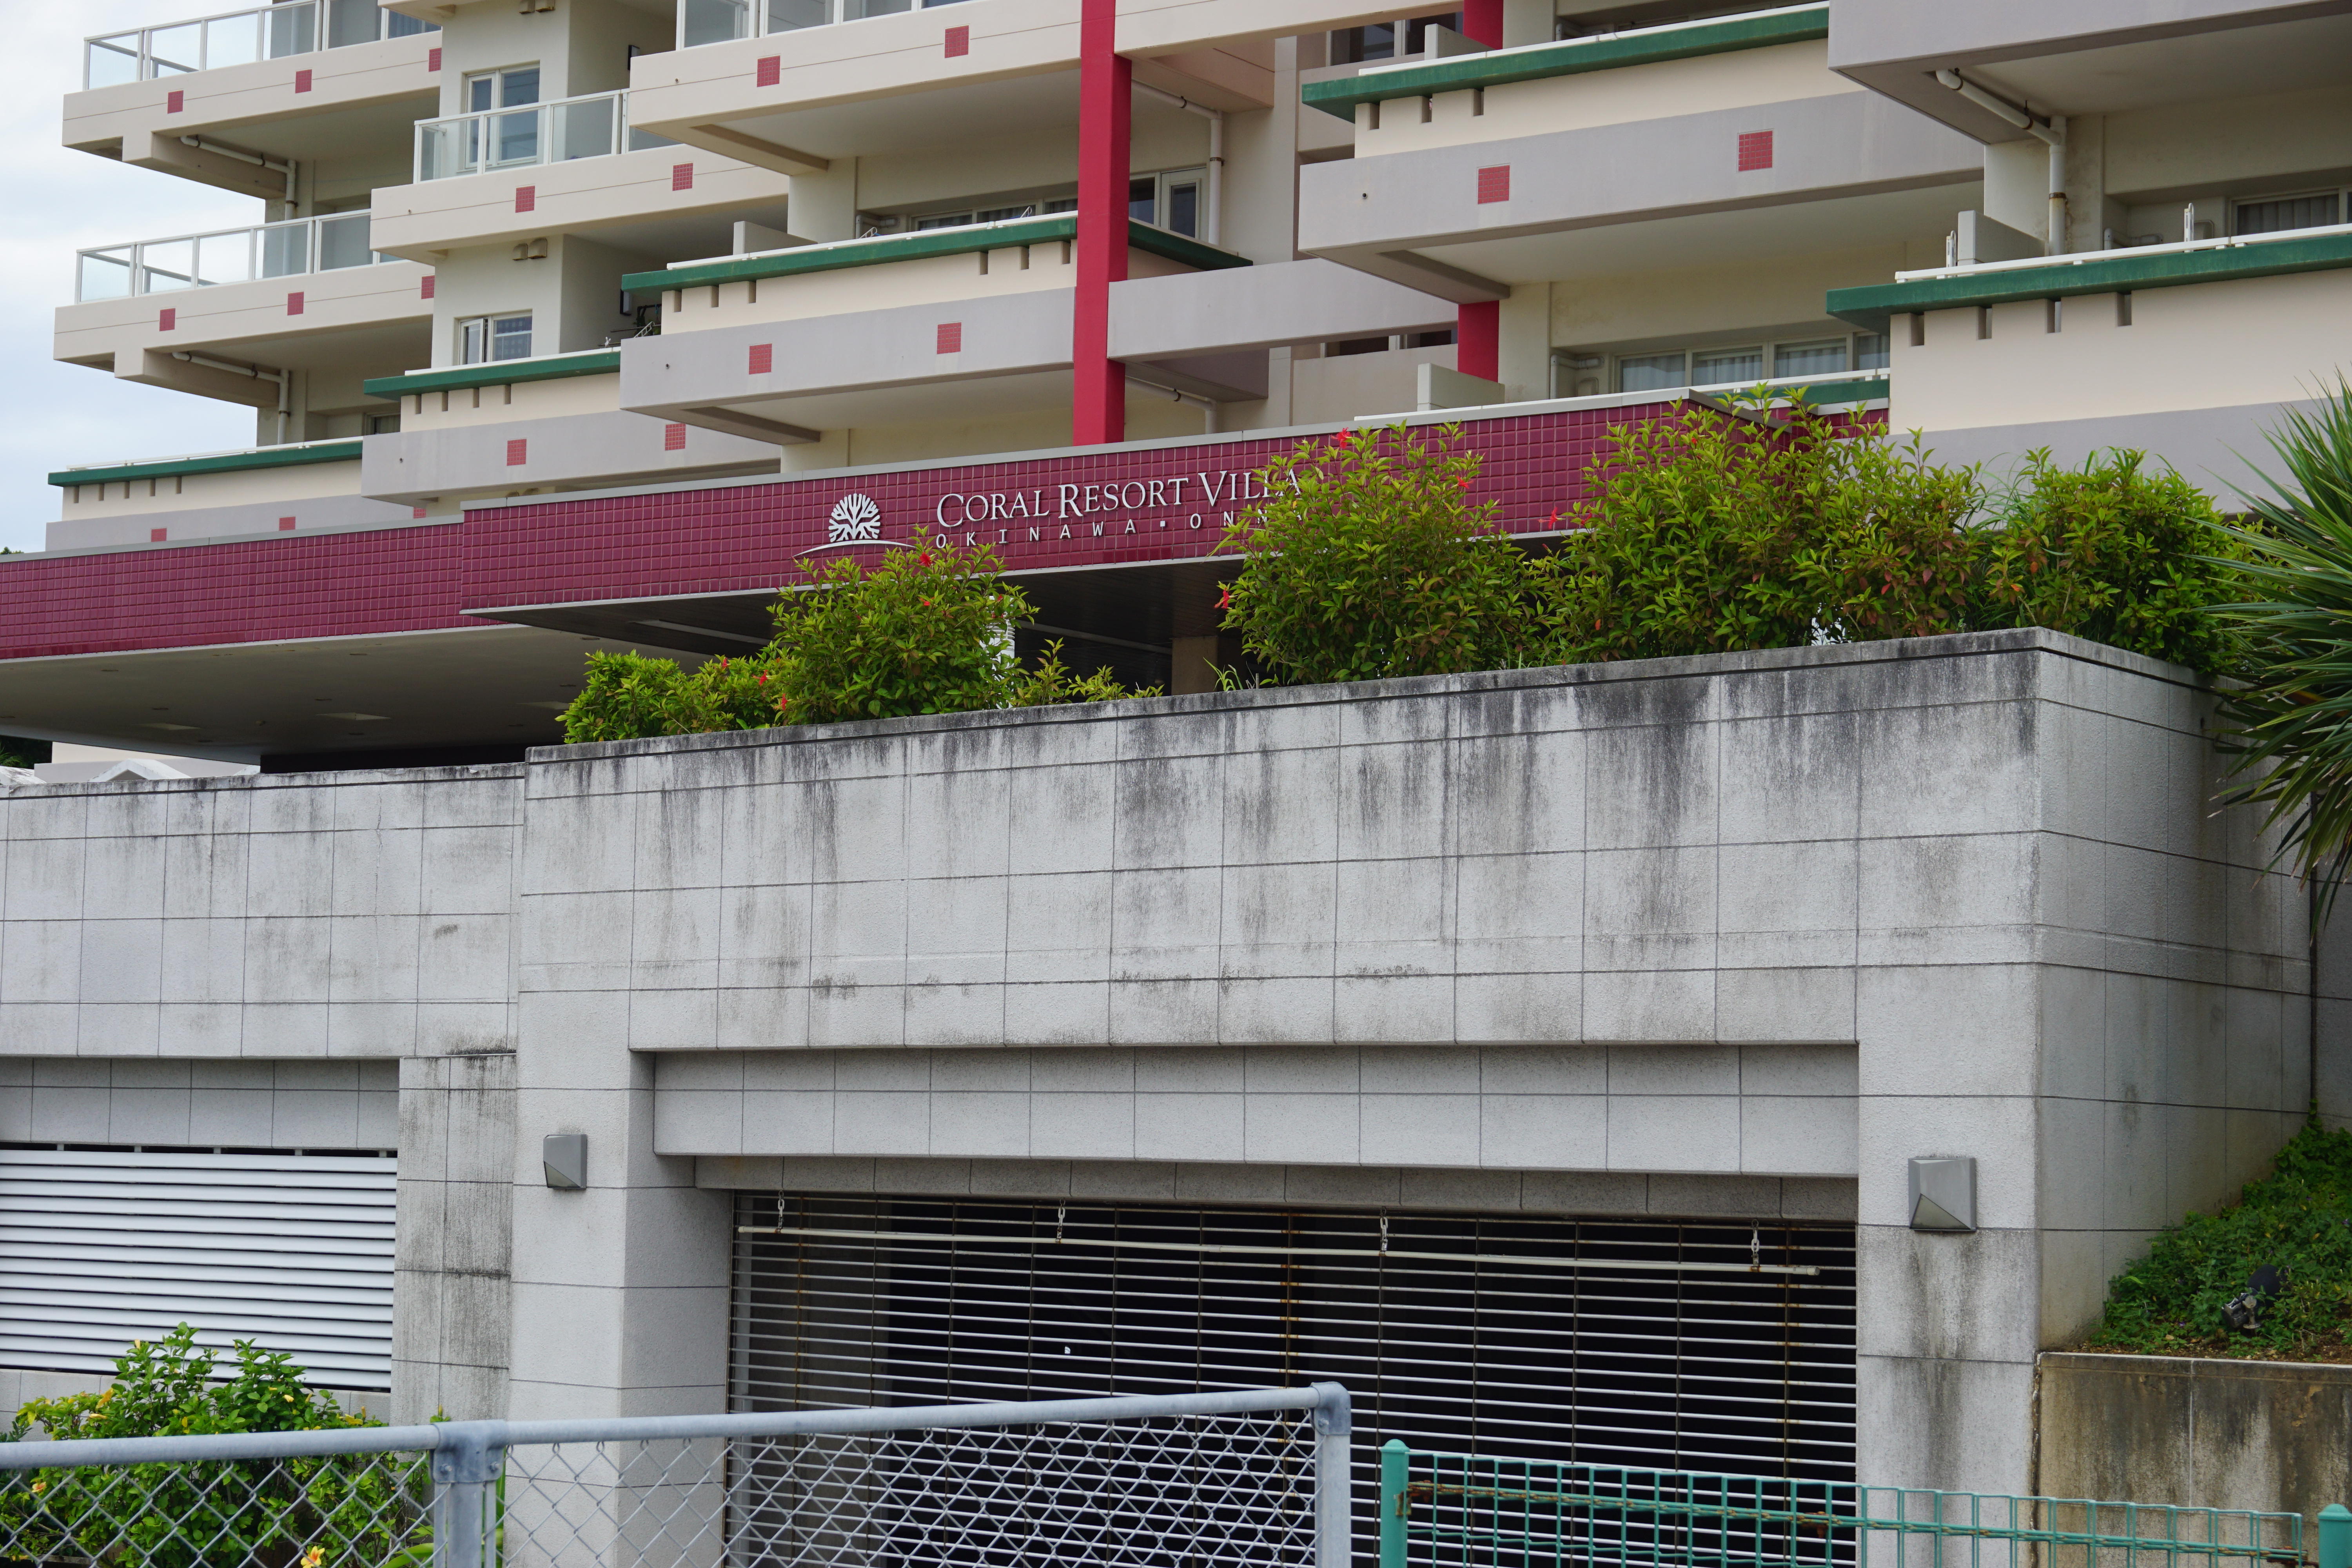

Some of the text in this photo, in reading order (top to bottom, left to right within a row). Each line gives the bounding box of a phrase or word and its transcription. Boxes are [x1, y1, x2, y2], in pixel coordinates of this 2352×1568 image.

[937, 468, 1301, 527] CORAL RESORT VILLA
[936, 519, 1136, 548] OKINAWA
